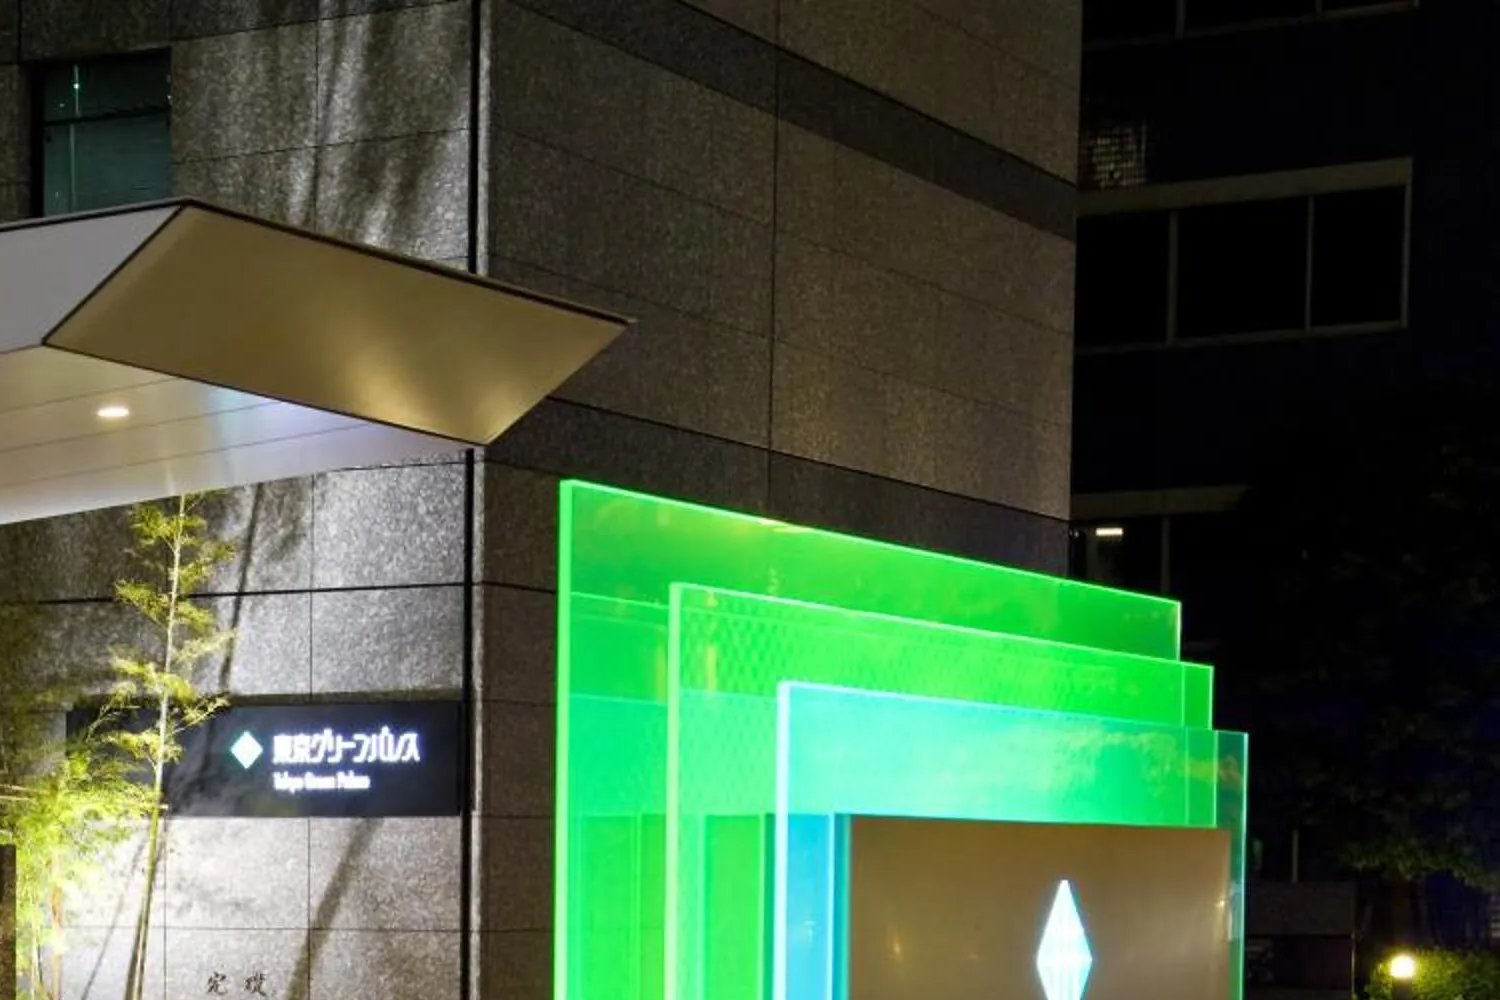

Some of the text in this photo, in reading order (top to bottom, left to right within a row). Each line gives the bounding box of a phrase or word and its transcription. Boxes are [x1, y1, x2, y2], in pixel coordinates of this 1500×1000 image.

[273, 726, 420, 764] 東京グリーンパレス
